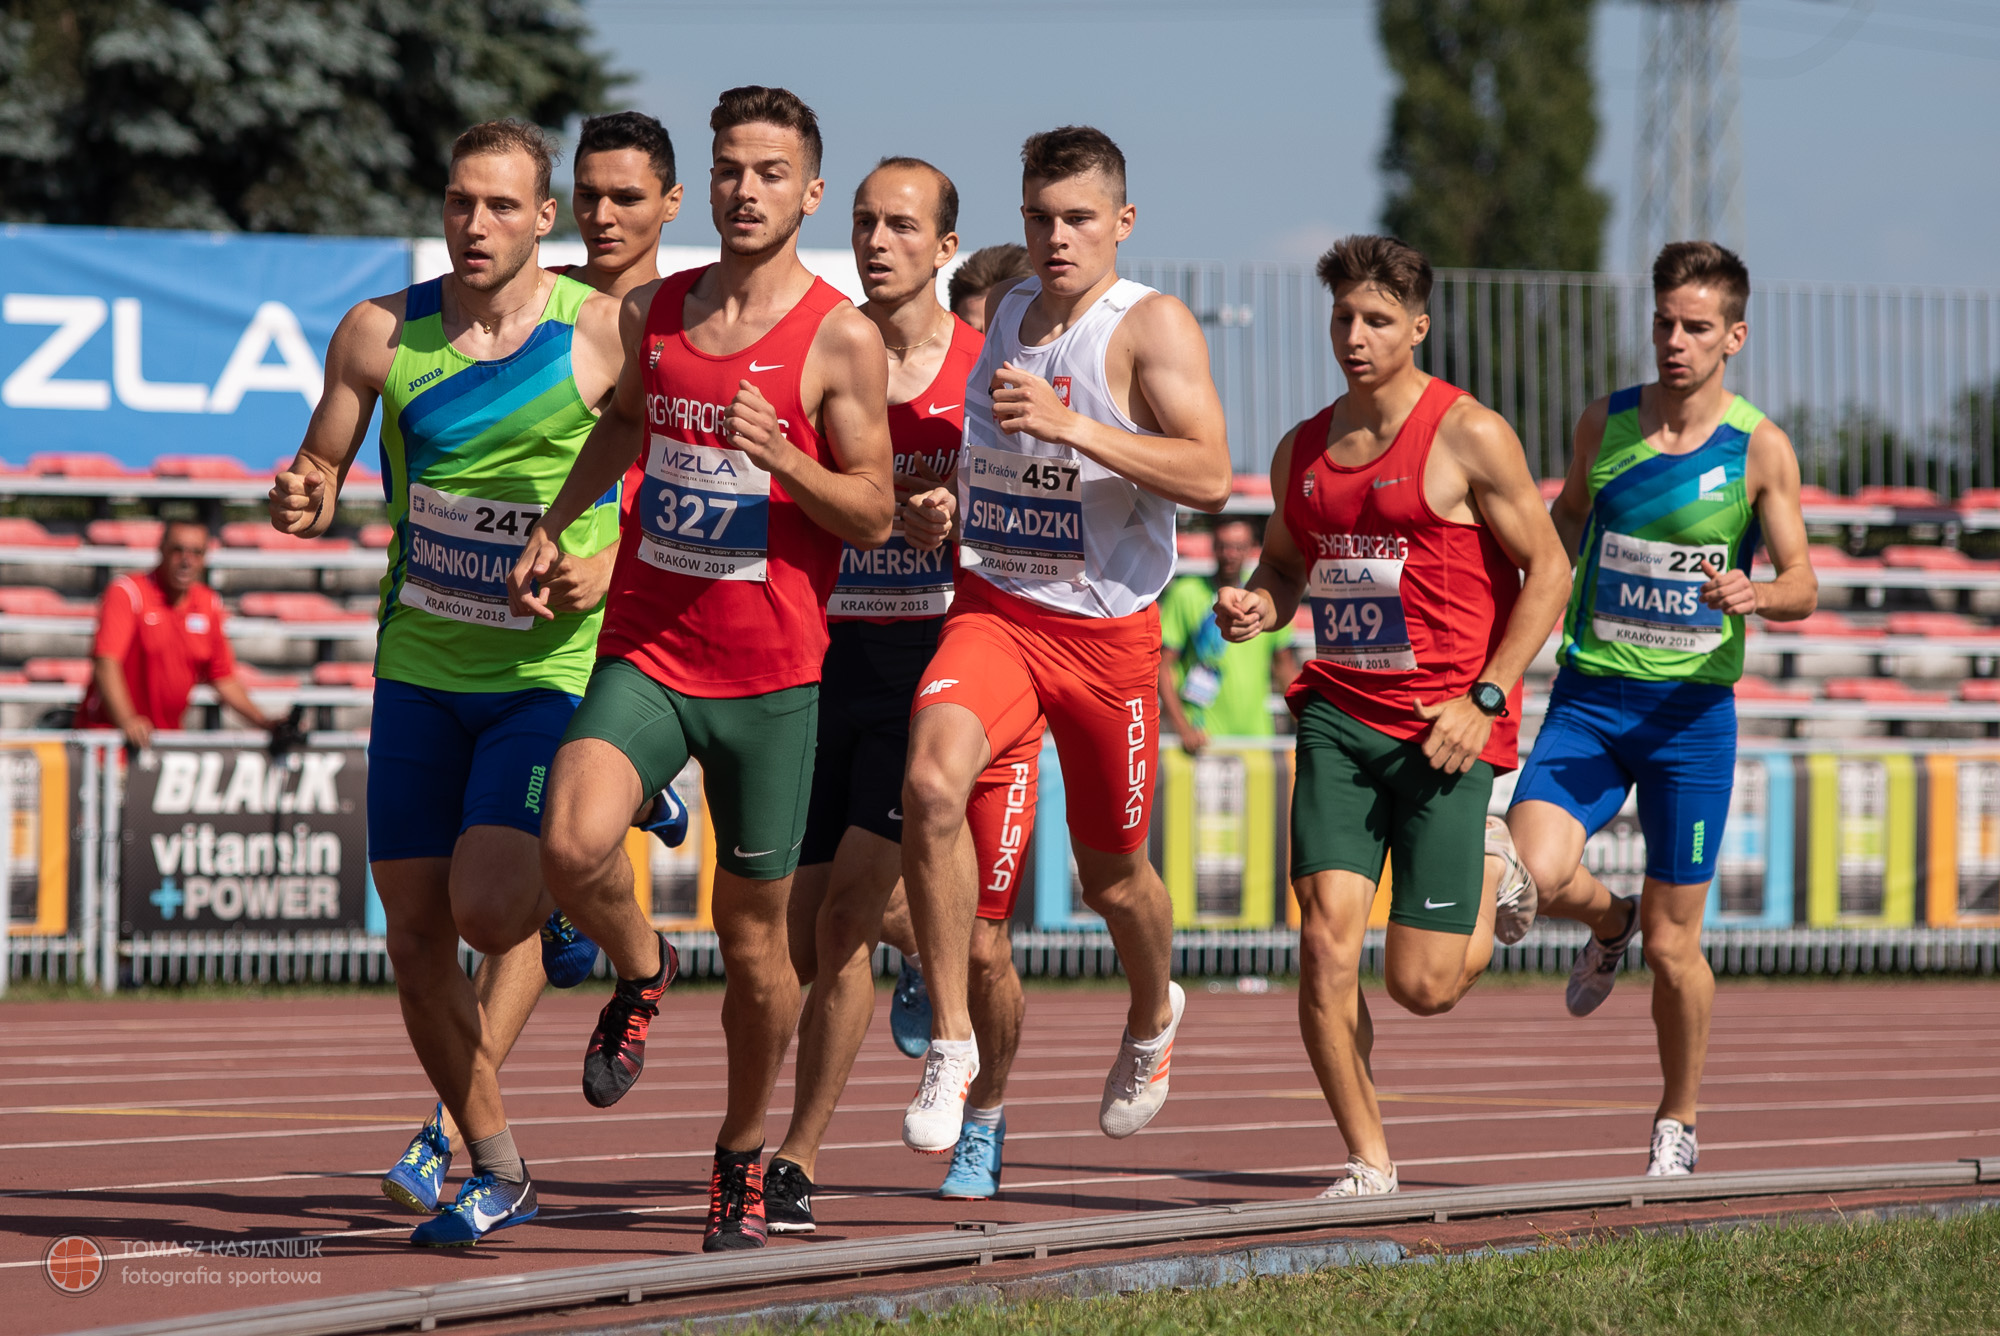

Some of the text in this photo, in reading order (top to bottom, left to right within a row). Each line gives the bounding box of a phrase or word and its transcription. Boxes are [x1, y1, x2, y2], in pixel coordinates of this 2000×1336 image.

[2, 293, 327, 414] ZLA
[662, 446, 737, 478] MZLA
[988, 463, 1079, 492] Kraków 457
[428, 502, 542, 537] Kraków 247
[656, 488, 738, 540] 327
[970, 499, 1079, 540] SIERADZKI
[653, 550, 736, 575] KRAKÓW 2018
[839, 546, 946, 575] YMERSKY
[980, 556, 1058, 576] KRAKÓW 2018
[1319, 567, 1375, 584] MZLA
[1668, 551, 1725, 573] 229
[425, 595, 506, 622] KRAKÓW 2018
[840, 597, 929, 612] KRAKÓW 2018
[1620, 583, 1699, 616] MARŠ
[1324, 602, 1383, 641] 349
[1366, 659, 1391, 670] 2018
[1122, 697, 1147, 830] POLSKA
[987, 763, 1029, 892] POLSKA
[151, 822, 341, 875] vitamin
